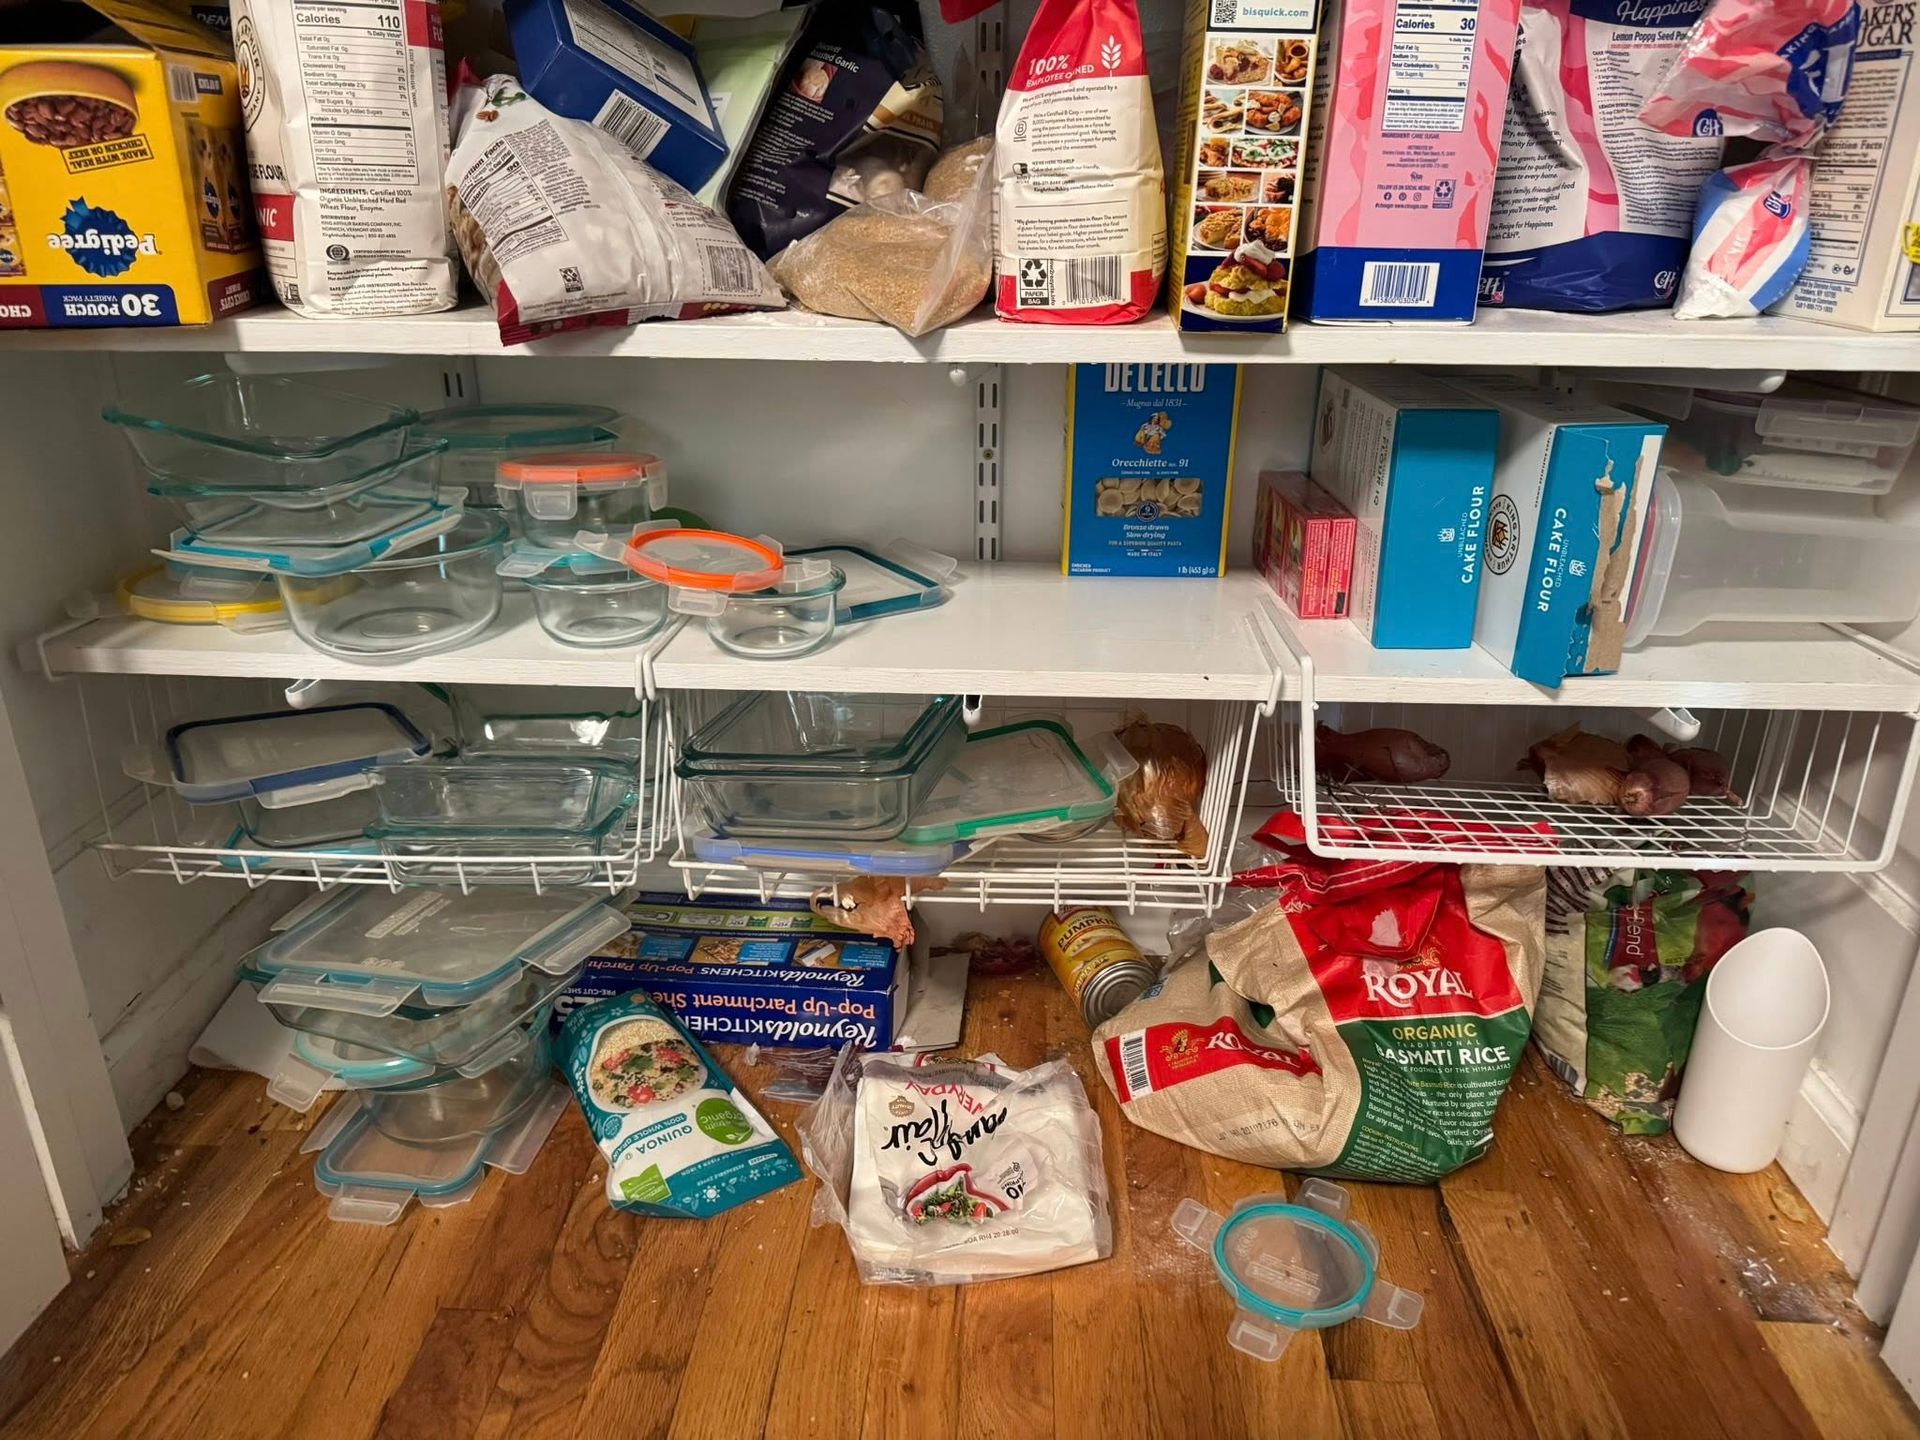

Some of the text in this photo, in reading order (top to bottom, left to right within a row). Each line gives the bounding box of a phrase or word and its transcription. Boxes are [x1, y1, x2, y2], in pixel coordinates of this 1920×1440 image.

[296, 13, 400, 29] Calories 110
[1243, 7, 1309, 19] bisquick.com
[1617, 0, 1705, 25] Happines
[1861, 2, 1917, 27] AKER'S
[1396, 18, 1476, 30] Calories 30
[1612, 32, 1674, 44] Lemon Poppy Seed
[1781, 24, 1818, 60] AKING
[835, 56, 860, 73] Garlic
[1029, 54, 1070, 76] 100%
[1026, 72, 1063, 88] EMPLOYEE
[68, 138, 143, 160] CHICKEN OR BEEF
[1861, 140, 1883, 150] Facts
[70, 150, 148, 170] MADE WITH REAL
[260, 164, 287, 181] FLOUR
[320, 188, 368, 196] INGREDIENTS:
[1524, 220, 1554, 230] Happiness
[46, 228, 158, 256] Pedigree
[64, 303, 120, 316] POUCH
[121, 293, 162, 316] 30
[1165, 398, 1182, 407] 1831
[1112, 458, 1190, 468] Orecchiette 91
[1506, 502, 1518, 530] KING
[1142, 532, 1166, 540] drying
[1457, 512, 1468, 558] UNBLEACHED
[1462, 486, 1485, 584] CAKE FLOUR
[1537, 508, 1568, 613] CAKE FLOUR
[1554, 539, 1570, 588] UNBLEACHED
[639, 962, 694, 975] Pop-Up
[582, 988, 616, 996] PRE-CUT
[1360, 967, 1474, 1008] ROYAL
[693, 994, 797, 1014] Parchment
[804, 1002, 876, 1020] Pop-Up
[1392, 1023, 1478, 1041] ORGANIC
[1375, 1042, 1511, 1066] BASMATI RICE
[1410, 1066, 1443, 1074] FOOTHILLS
[1455, 1066, 1470, 1074] THE
[1472, 1062, 1511, 1073] HIMALAYAS
[1464, 1080, 1496, 1088] cultivated
[1449, 1090, 1486, 1098] only place
[1450, 1100, 1458, 1108] by
[1460, 1100, 1484, 1109] organic
[700, 1111, 745, 1124] organic
[1366, 1112, 1376, 1120] for
[1376, 1116, 1388, 1127] any
[612, 1114, 686, 1162] 100% WHOLE GRAIN
[635, 1124, 694, 1154] QUINOA
